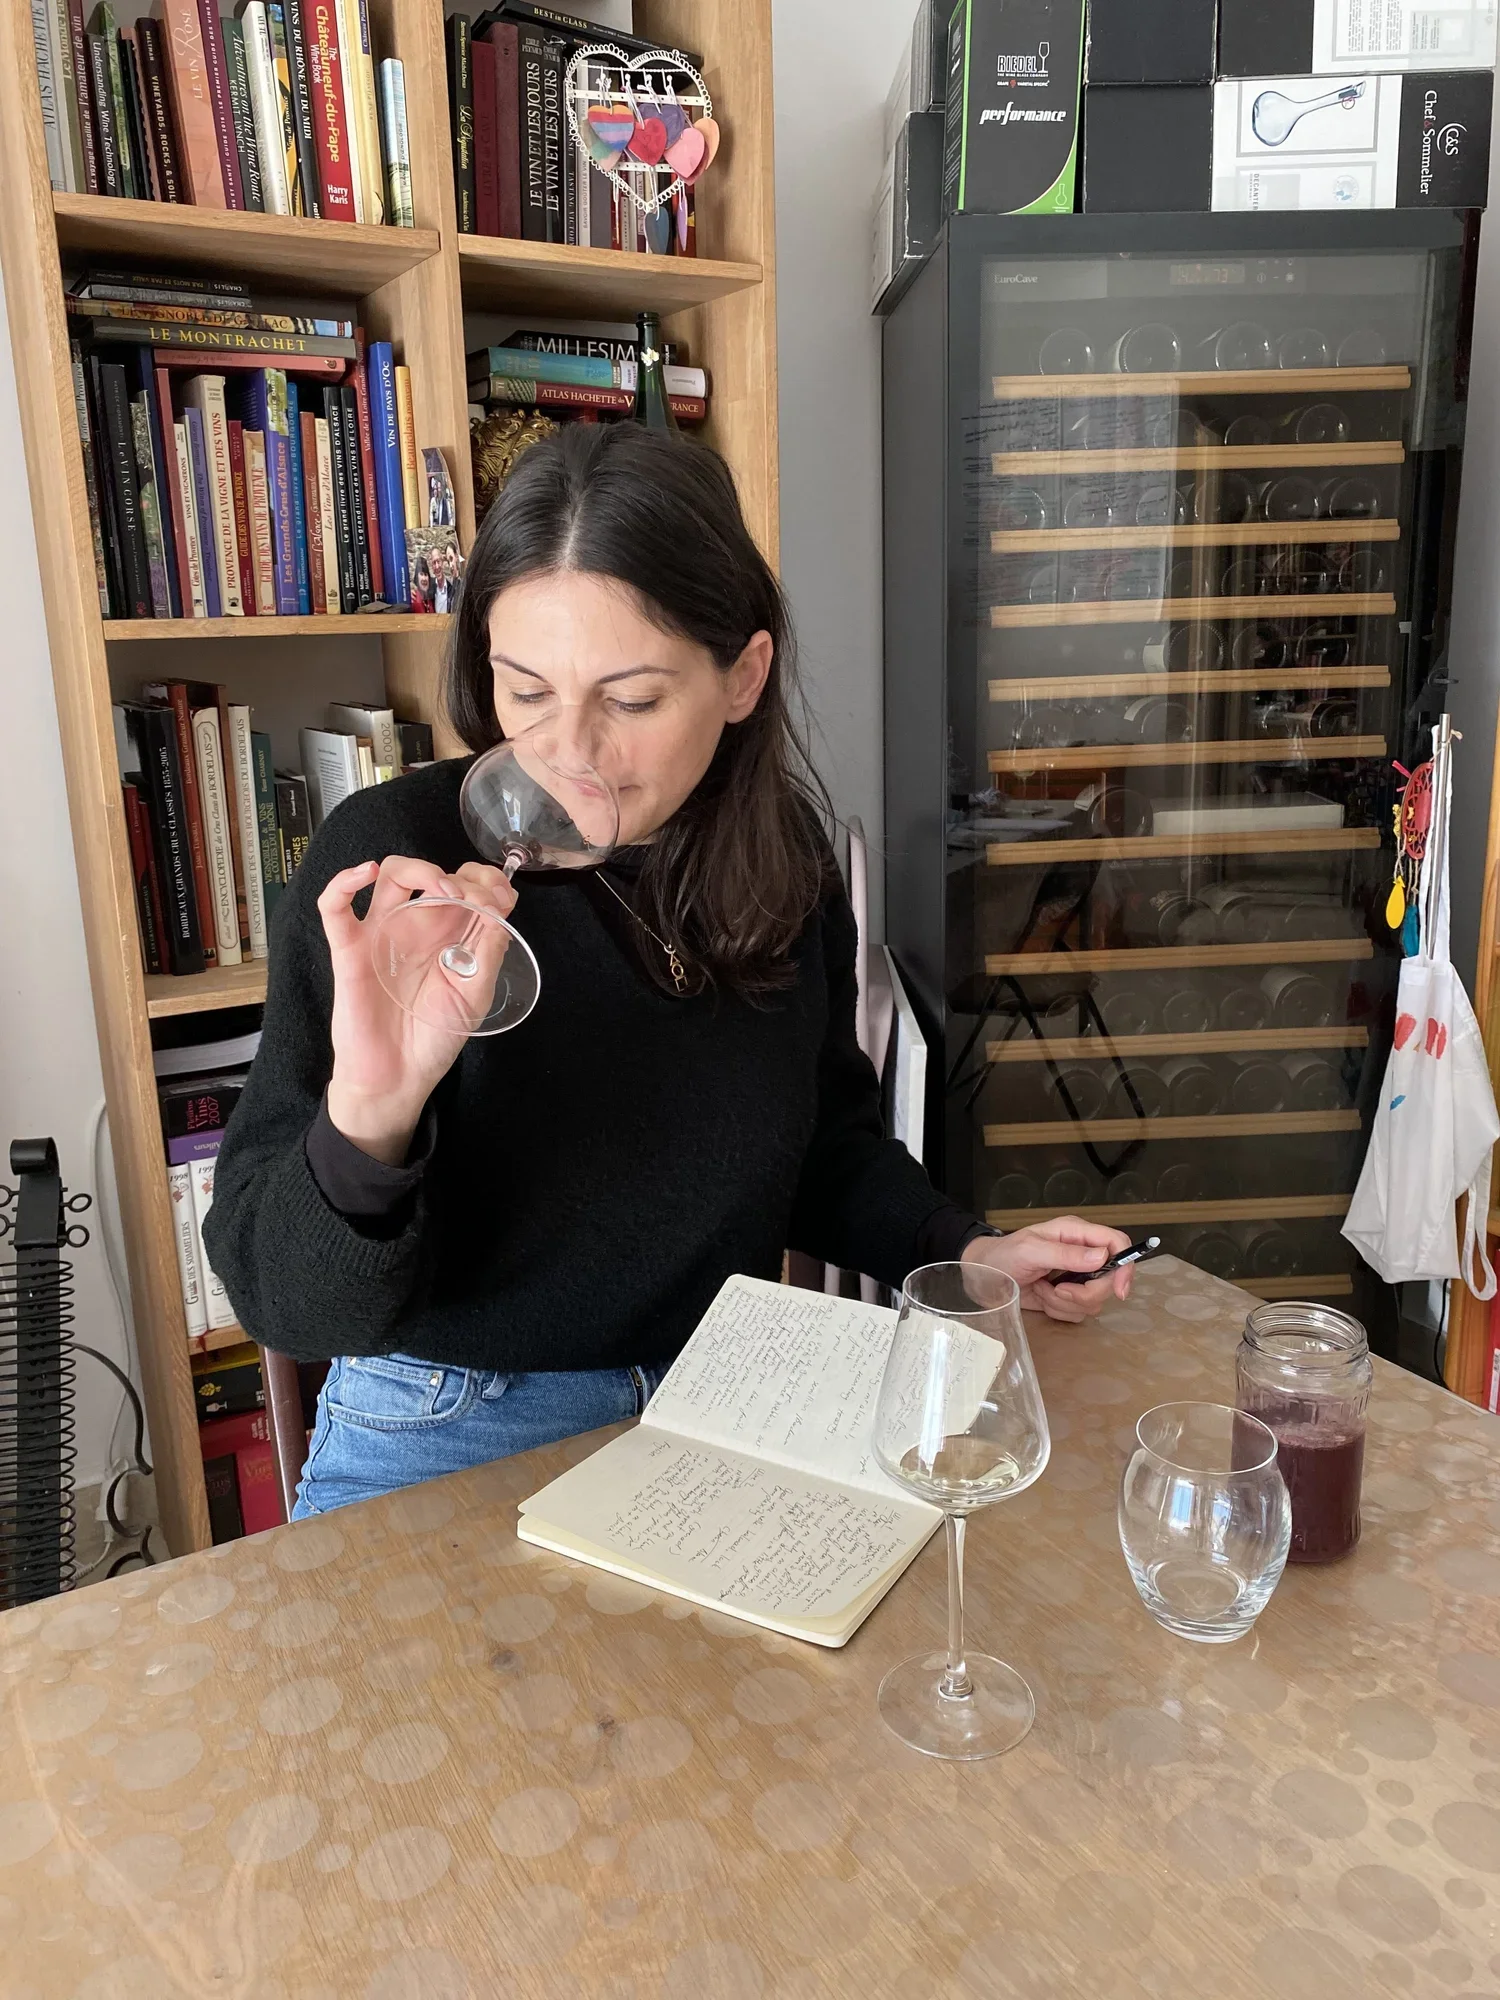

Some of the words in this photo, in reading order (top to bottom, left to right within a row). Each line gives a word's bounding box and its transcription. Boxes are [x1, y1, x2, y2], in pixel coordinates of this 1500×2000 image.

[290, 1, 300, 25] VINS
[533, 7, 553, 20] BEST
[562, 16, 588, 29] CLASS
[74, 16, 82, 35] vin
[292, 28, 302, 44] DU
[32, 2, 51, 80] HACHETTE
[73, 36, 82, 49] de
[232, 31, 247, 97] Adventures
[310, 44, 319, 63] Wine
[329, 47, 337, 60] The
[998, 56, 1037, 73] RIEDEL
[74, 52, 89, 105] l'amateur
[93, 41, 106, 107] Understanding
[189, 59, 200, 80] VIN
[311, 64, 321, 84] Book
[193, 83, 203, 99] LE
[299, 85, 308, 99] ET
[315, 6, 340, 163] Châteauneuf-du-Pape
[526, 62, 541, 109] JOURS
[543, 69, 558, 115] JOURS
[40, 85, 56, 130] ATLAS
[229, 79, 240, 116] KERMIT
[244, 100, 250, 113] on
[84, 110, 90, 119] de
[301, 101, 310, 117] DU
[979, 102, 1066, 125] performance
[100, 110, 110, 133] Wine
[152, 75, 165, 131] VINEYARDS,
[160, 133, 170, 167] ROCKS,
[244, 115, 253, 133] the
[303, 119, 312, 139] MIDI
[527, 108, 541, 133] LES
[544, 114, 558, 139] LES
[85, 120, 93, 145] insolite
[234, 120, 245, 153] LYNCH
[246, 133, 256, 167] Wine
[528, 140, 541, 155] ET
[545, 145, 559, 160] ET
[86, 146, 96, 177] voyage
[103, 136, 116, 187] Technology
[529, 157, 543, 184] VIN
[90, 178, 97, 188] Le
[248, 169, 260, 202] Route
[546, 161, 559, 189] VIN
[327, 185, 348, 196] Harry
[330, 194, 348, 205] Karis
[530, 190, 543, 207] LE
[547, 195, 559, 211] LE
[994, 273, 1038, 284] EuroCave
[149, 327, 171, 340] LE
[180, 330, 306, 352] MONTRACHET
[536, 337, 636, 361] MILLESIM
[384, 390, 393, 410] PAYS
[541, 388, 569, 400] ATLAS
[570, 391, 617, 404] HACHETTE
[212, 412, 223, 436] VINS
[289, 400, 298, 458] BOURGOGNE
[332, 406, 342, 446] D'ALSACE
[347, 407, 355, 433] LOIRE
[385, 413, 394, 426] DE
[215, 440, 225, 459] DES
[350, 436, 356, 448] DE
[386, 430, 396, 449] VIN
[404, 418, 415, 471] Beaujolais
[217, 462, 226, 473] ET
[336, 449, 344, 469] VINS
[351, 451, 359, 470] VINS
[119, 460, 132, 485] VIN
[181, 457, 191, 493] VIGNERONS
[218, 476, 229, 506] VIGNE
[251, 467, 266, 508] PROVENCE
[123, 489, 135, 533] CORSE
[279, 491, 291, 517] Crus
[323, 493, 332, 512] Vins
[221, 509, 230, 520] LA
[237, 510, 246, 523] VINS
[255, 510, 267, 521] DE
[222, 522, 232, 536] DE
[238, 525, 247, 536] DES
[256, 524, 269, 540] VINS
[343, 533, 349, 543] Le
[189, 536, 199, 563] Provence
[239, 537, 249, 557] GUIDE
[258, 542, 270, 556] DES
[280, 520, 292, 561] Grands
[358, 535, 364, 546] Le
[223, 541, 236, 589] PROVENCE
[260, 559, 273, 583] GUIDE
[284, 565, 293, 583] Les
[237, 719, 249, 766] BORDELAIS
[381, 723, 393, 752] 2000
[204, 743, 217, 791] BORDELAIS
[240, 768, 249, 781] DU
[241, 783, 254, 830] BOURGEOIS
[259, 803, 267, 822] VINS
[169, 832, 180, 855] CRUS
[246, 832, 255, 854] CRUS
[268, 834, 277, 846] DU
[248, 856, 257, 872] DES
[260, 840, 272, 885] VIGNOBLES
[172, 857, 185, 892] GRANDS
[176, 893, 191, 940] BORDEAUX
[196, 1097, 208, 1132] Vins
[208, 1096, 220, 1125] 2007
[169, 1173, 189, 1182] 1998
[181, 1220, 193, 1265] SOMMELIERS
[185, 1264, 195, 1282] DES
